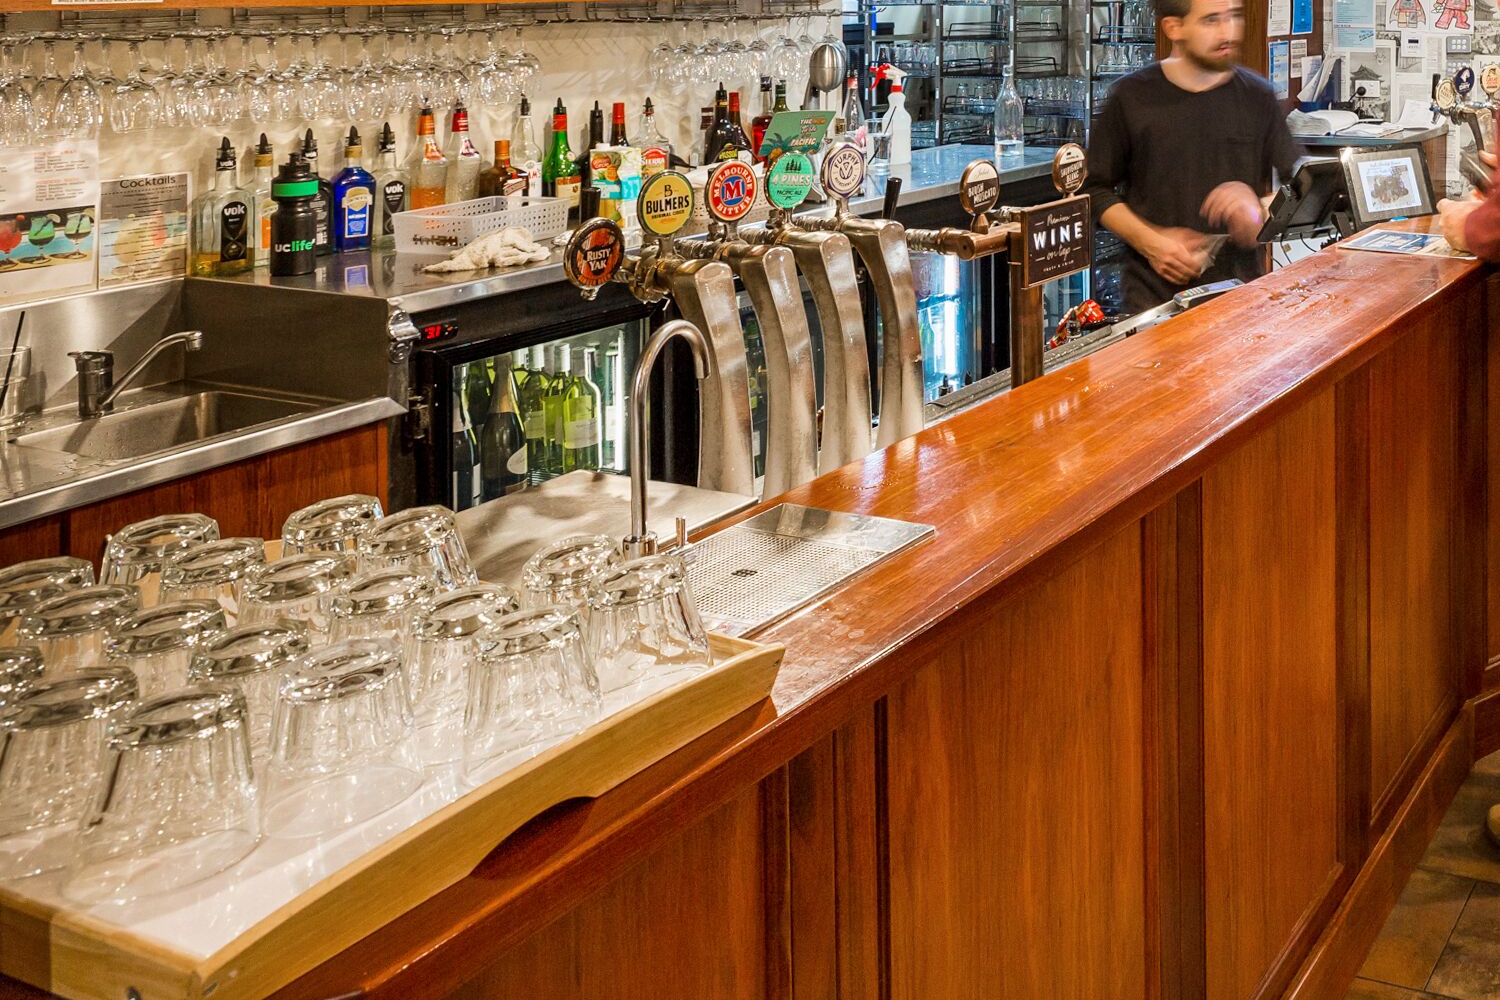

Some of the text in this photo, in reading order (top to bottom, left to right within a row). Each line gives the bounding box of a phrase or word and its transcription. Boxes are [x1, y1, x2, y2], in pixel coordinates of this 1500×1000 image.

[834, 153, 859, 169] FURPHY
[119, 175, 176, 189] Cocktails
[713, 166, 752, 198] MELBOURNE
[781, 174, 811, 186] PINES
[664, 184, 673, 198] B
[723, 180, 744, 201] M
[646, 194, 690, 214] BULMERS
[716, 196, 752, 215] BITTER
[1033, 221, 1083, 250] WINE
[586, 248, 611, 261] RUSTY
[589, 259, 607, 272] YAK
